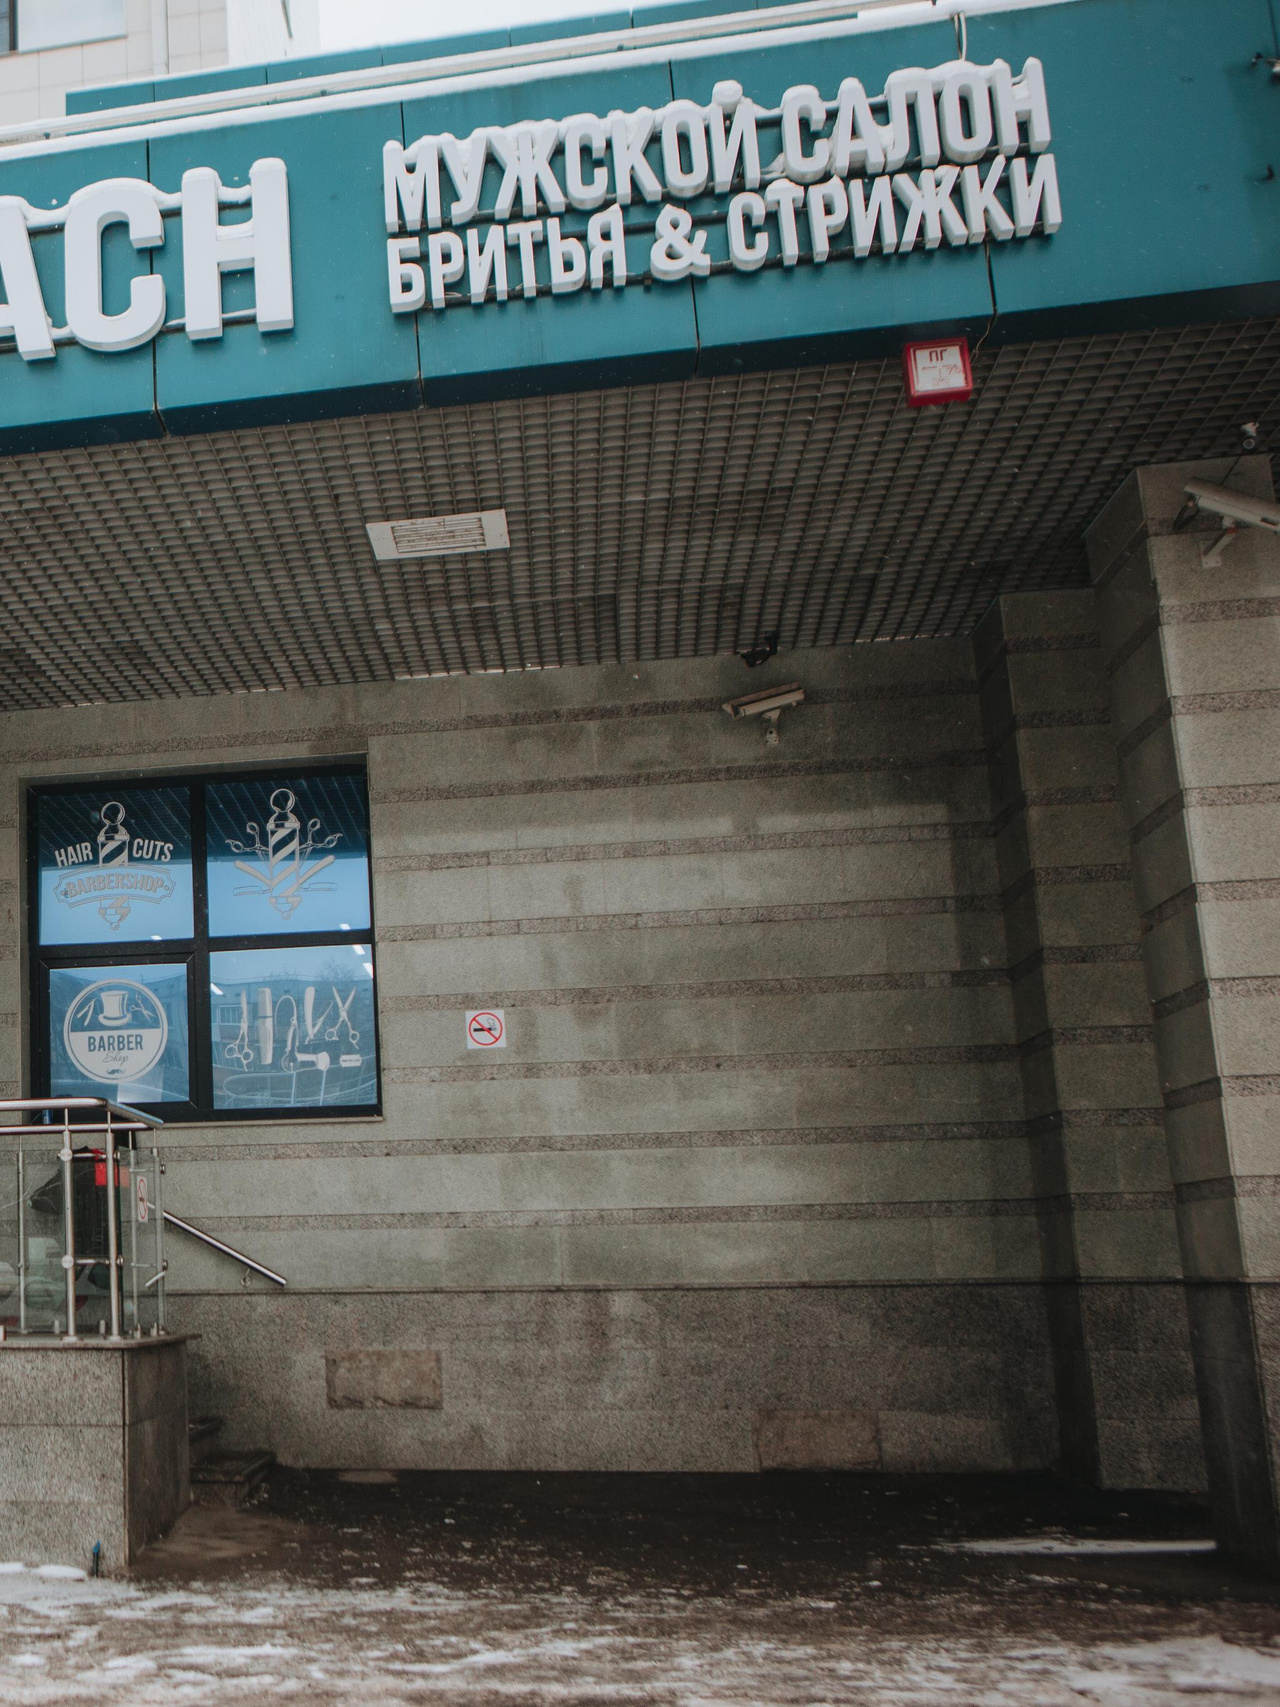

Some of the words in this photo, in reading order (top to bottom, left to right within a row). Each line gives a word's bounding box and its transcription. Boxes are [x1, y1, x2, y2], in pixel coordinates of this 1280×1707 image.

[382, 79, 760, 233] МУЖСКОЙ
[781, 57, 1052, 184] САЛОН
[387, 203, 627, 314] БРИТЬЯ
[649, 203, 711, 283] &
[726, 153, 1063, 272] СТРИЖКИ
[54, 841, 94, 869] HAIR
[132, 837, 174, 862] CUTS
[65, 872, 165, 899] BARBERSHOP
[87, 1034, 144, 1053] BARBER
[102, 1050, 129, 1067] Shop
